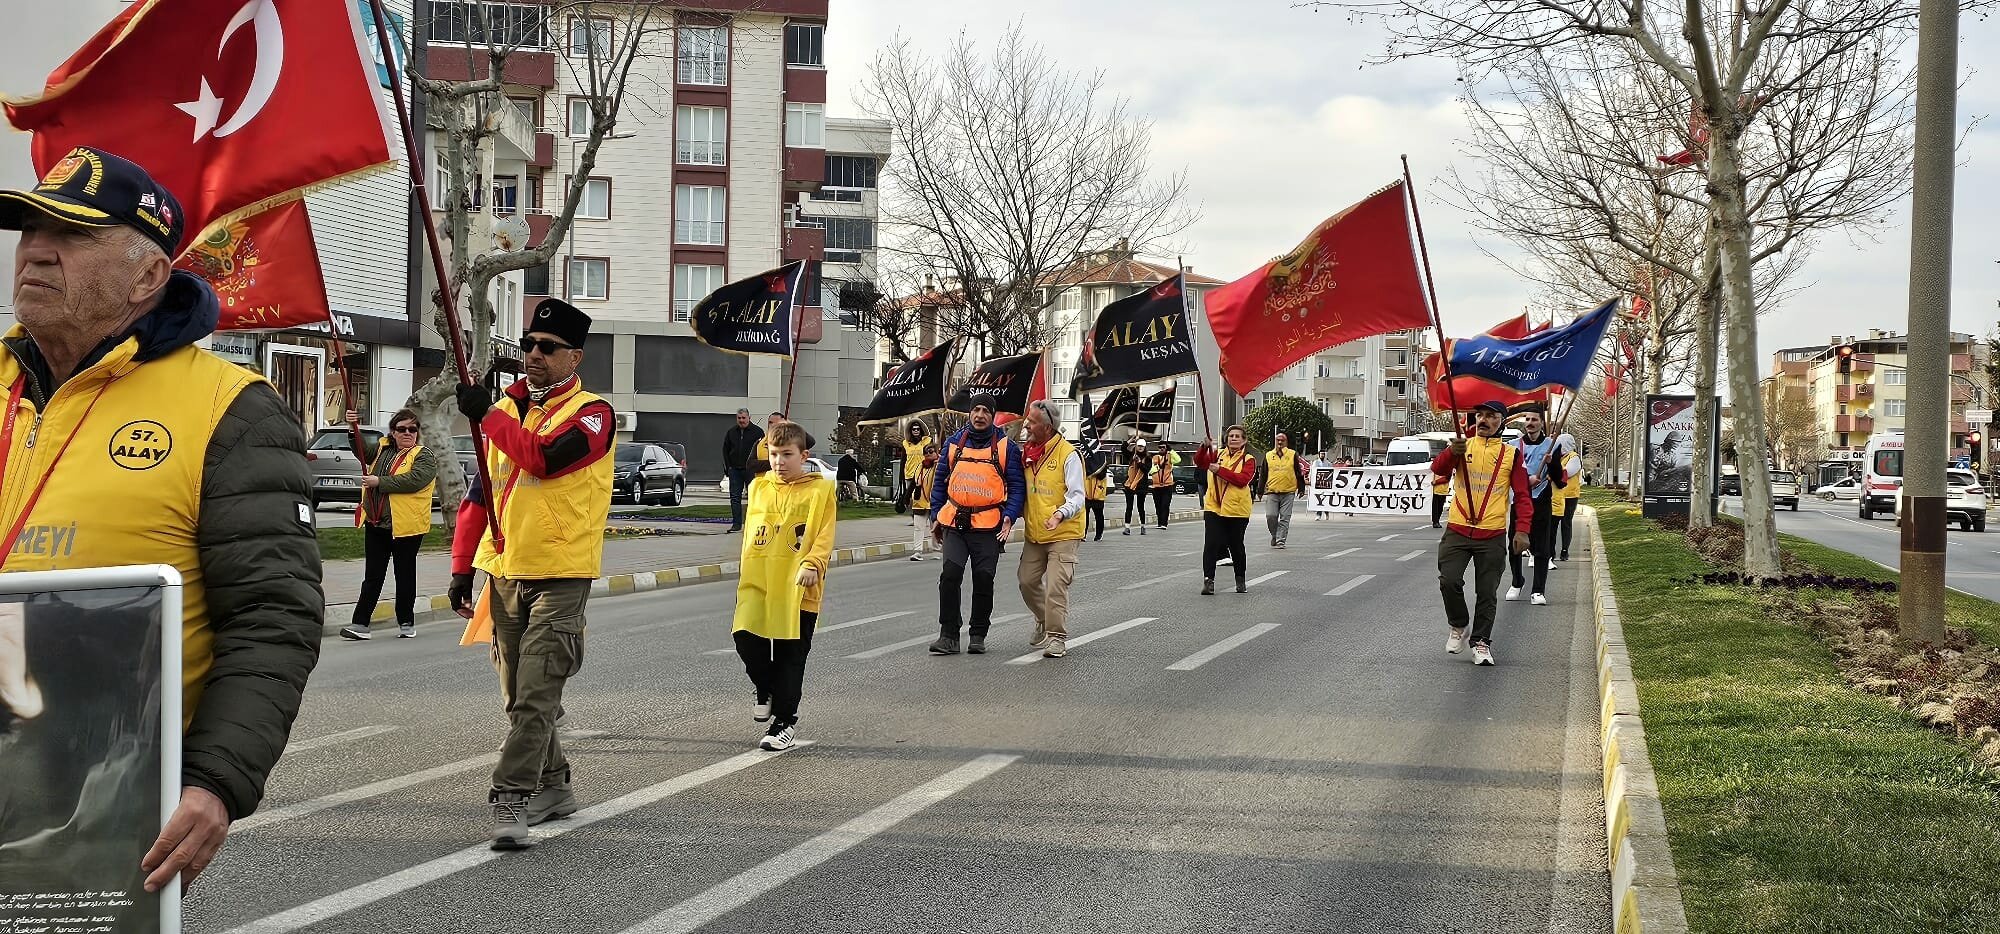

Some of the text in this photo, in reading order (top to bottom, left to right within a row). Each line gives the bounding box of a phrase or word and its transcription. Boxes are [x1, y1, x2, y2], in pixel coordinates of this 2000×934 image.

[737, 299, 783, 324] ALAY
[1100, 312, 1181, 350] ALAY
[1140, 340, 1192, 361] KEŞAN
[130, 430, 159, 443] 57.
[113, 445, 166, 462] ALAY
[1373, 473, 1427, 491] ALAY
[1314, 491, 1426, 514] YÜRÜYÜŞÜ
[12, 520, 78, 557] MEYİ
